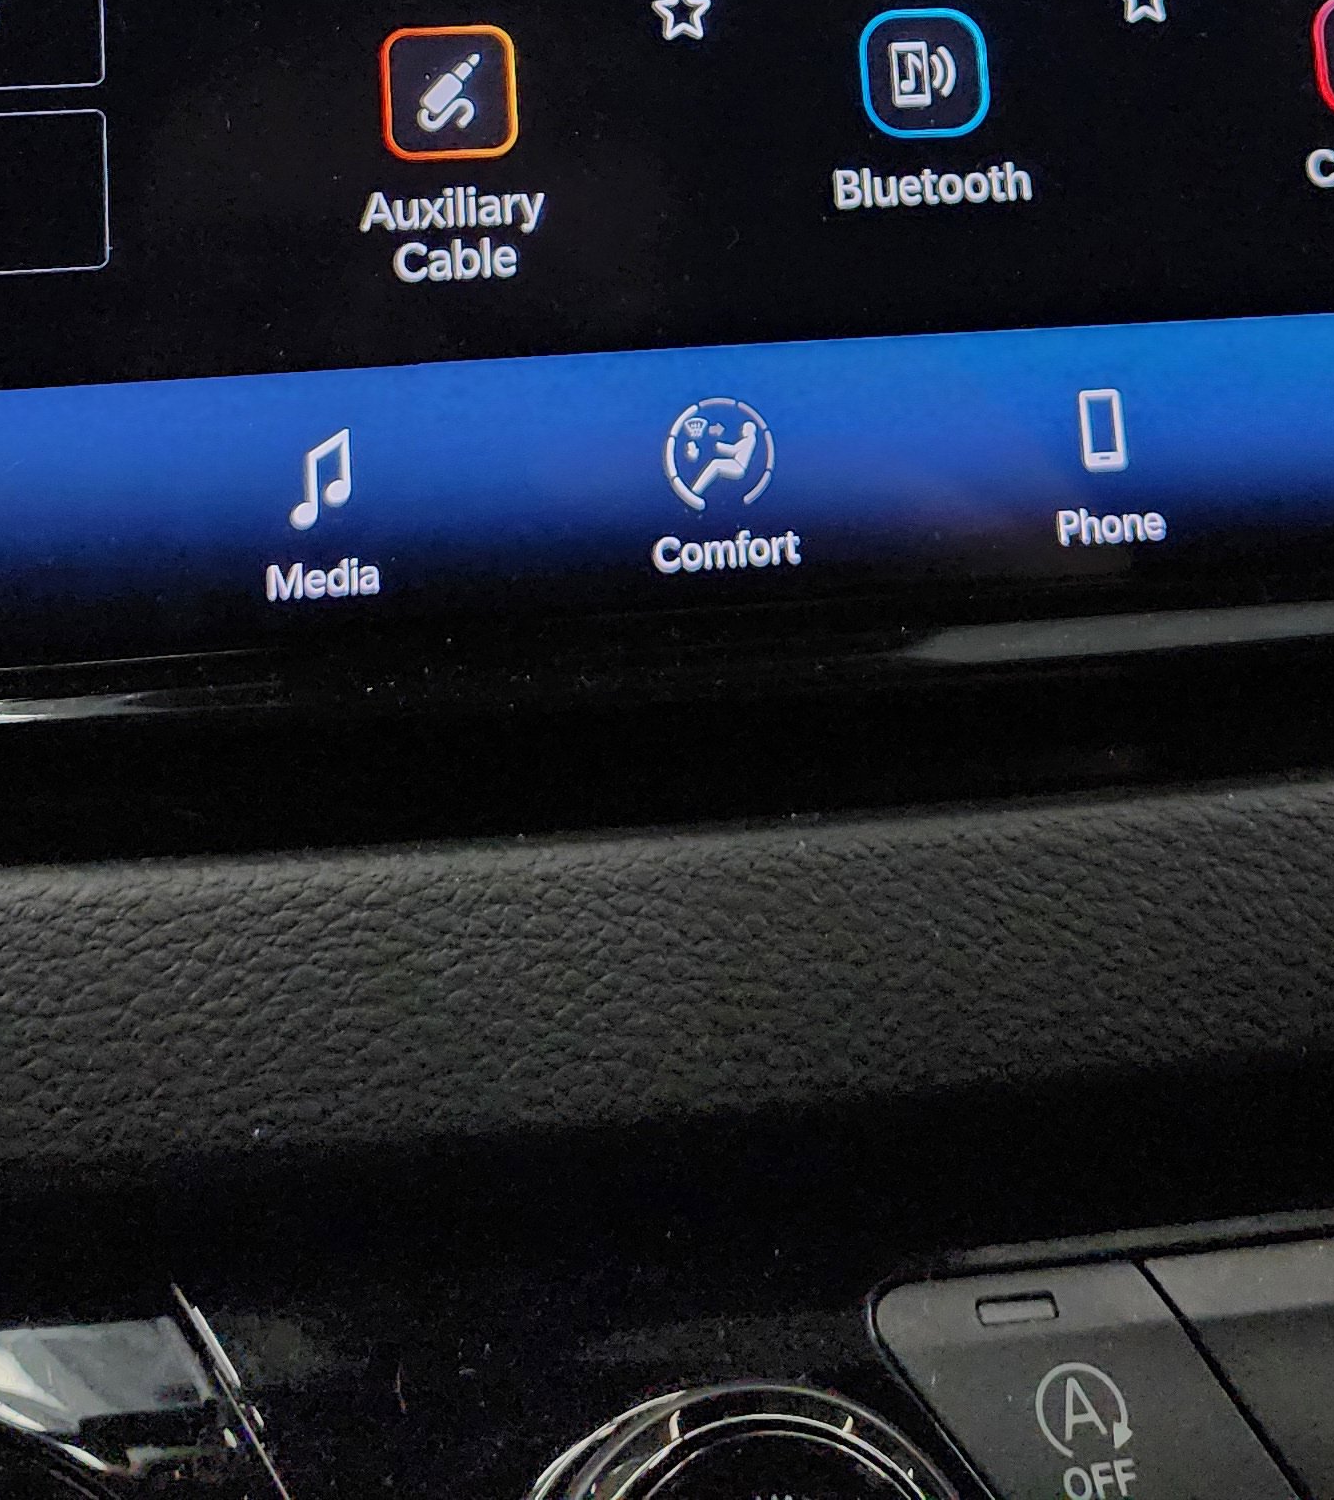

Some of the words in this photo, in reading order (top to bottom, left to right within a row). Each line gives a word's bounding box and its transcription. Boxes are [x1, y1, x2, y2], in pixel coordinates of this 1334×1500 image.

[359, 185, 546, 234] Auxiliary
[831, 160, 1035, 212] Bluetooth
[392, 237, 519, 284] Cable
[1055, 506, 1168, 548] Phone
[651, 527, 803, 575] Comfort
[264, 556, 382, 603] Media
[1064, 1376, 1108, 1442] A
[1062, 1457, 1137, 1500] OFF
